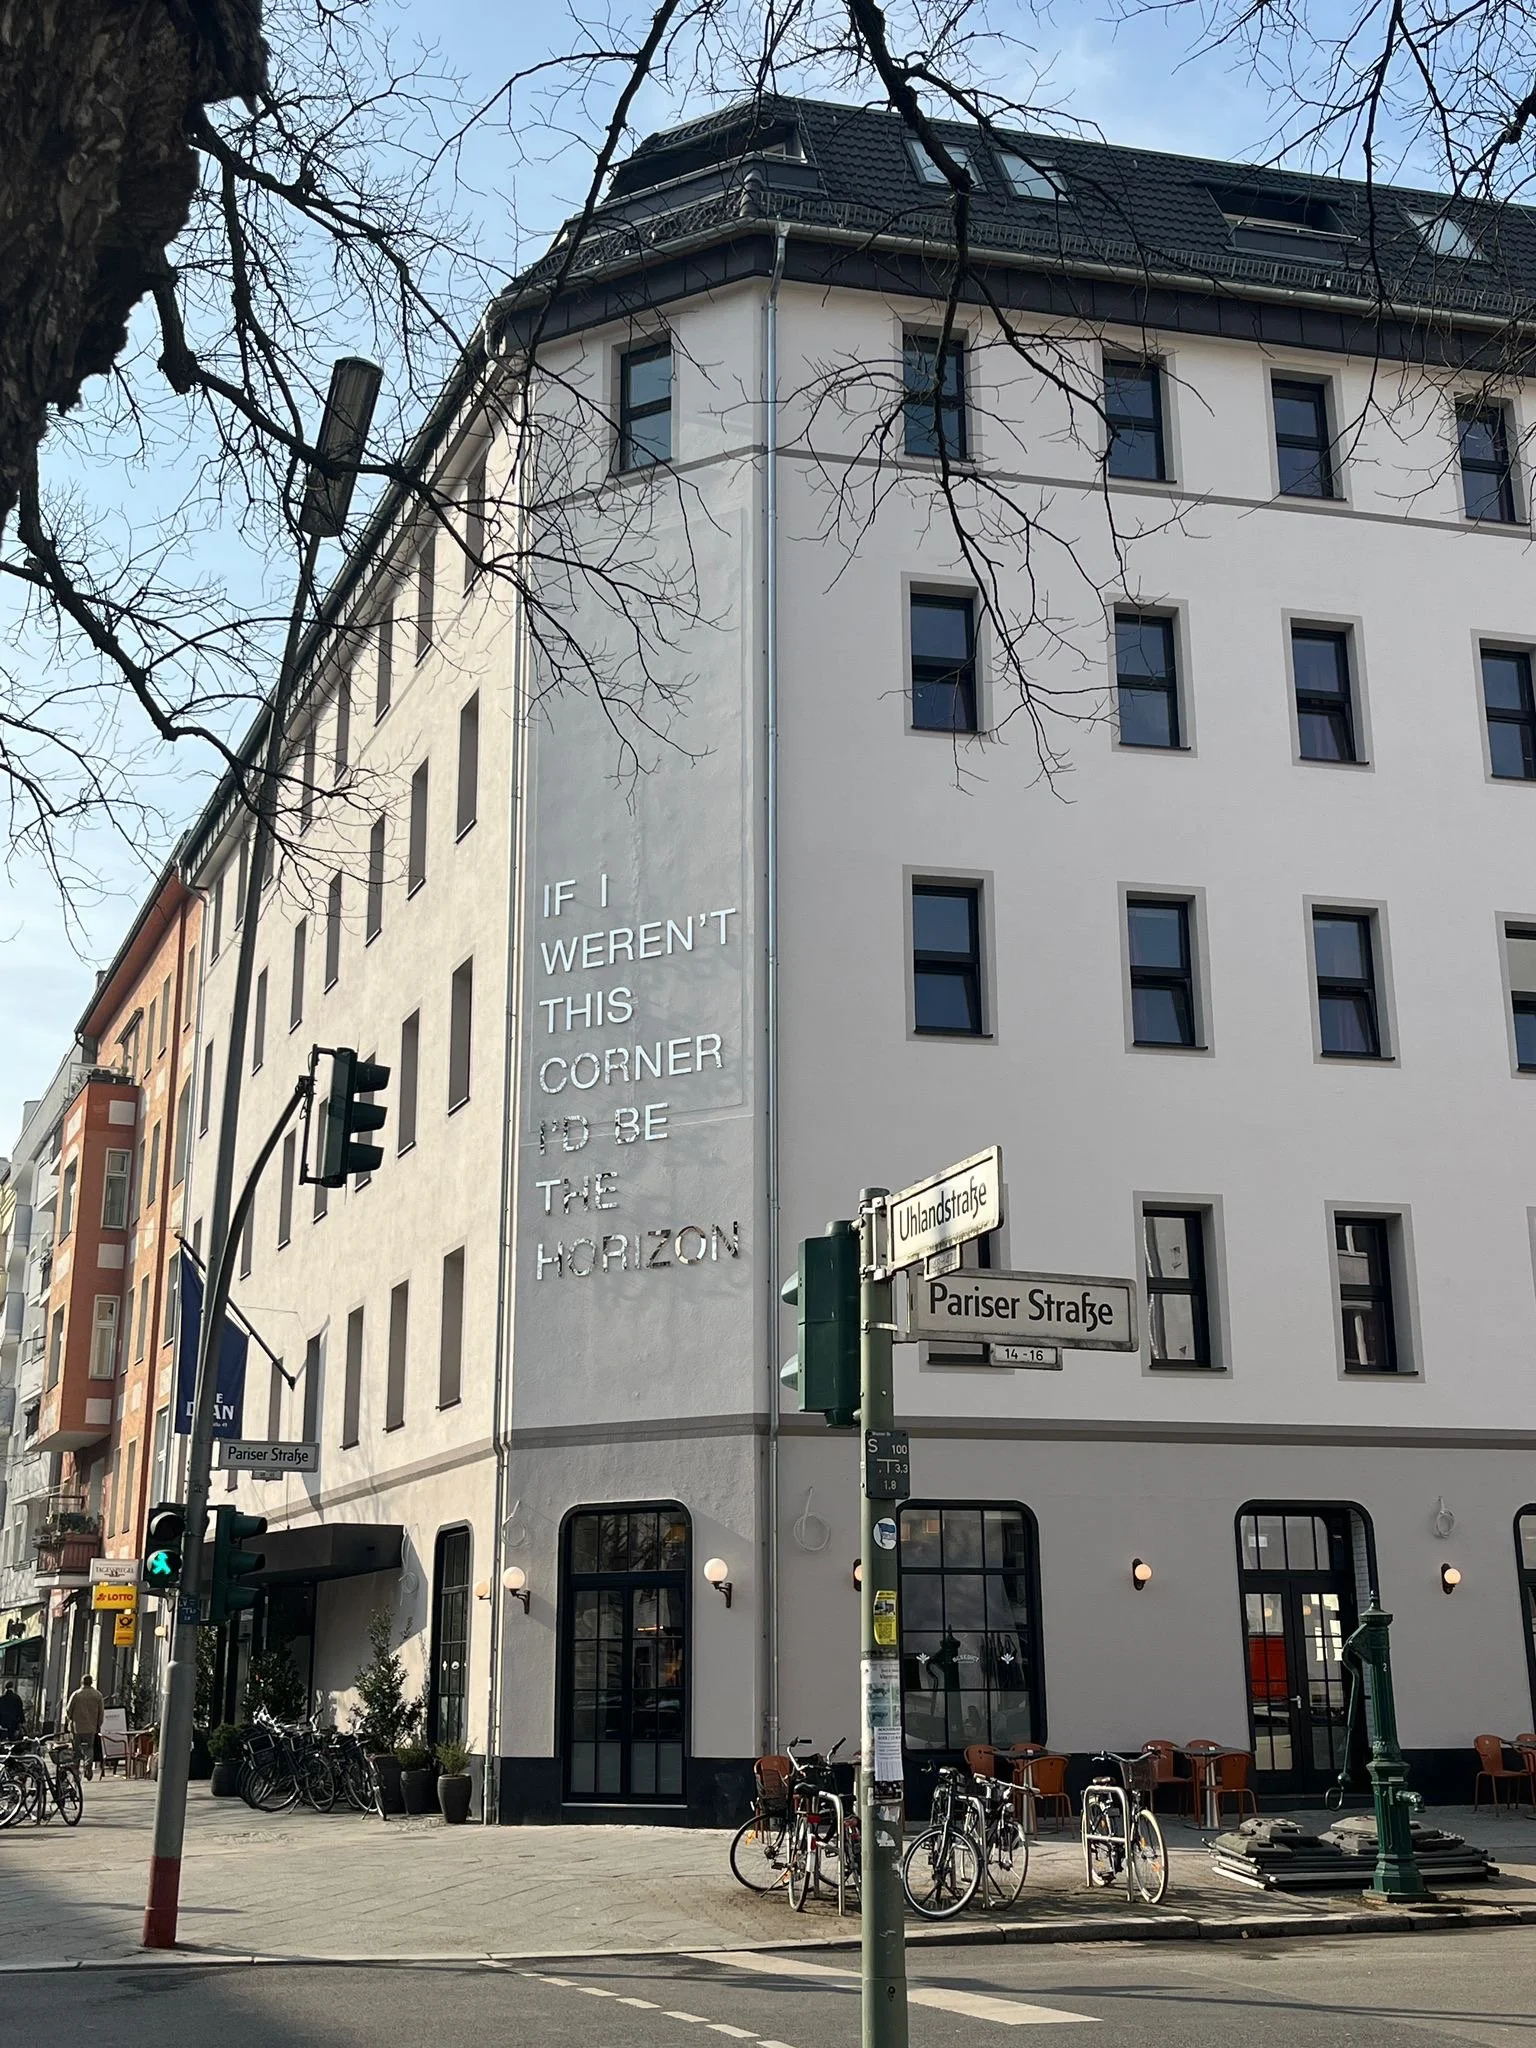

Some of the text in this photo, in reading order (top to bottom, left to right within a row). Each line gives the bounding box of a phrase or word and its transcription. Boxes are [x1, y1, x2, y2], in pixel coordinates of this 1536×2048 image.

[543, 873, 608, 918] IF I
[540, 908, 737, 975] WEREN'T
[539, 987, 633, 1034] THIS
[539, 1033, 723, 1094] CORNER
[539, 1103, 669, 1156] I'D BE
[536, 1171, 618, 1216] THE
[899, 1176, 987, 1241] Uhlandstraße
[536, 1221, 739, 1281] HORIZON
[929, 1282, 1114, 1332] Pariser Straße
[228, 1446, 309, 1465] Pariser Straße
[868, 1438, 908, 1455] S 100
[108, 1593, 134, 1601] LOTTO
